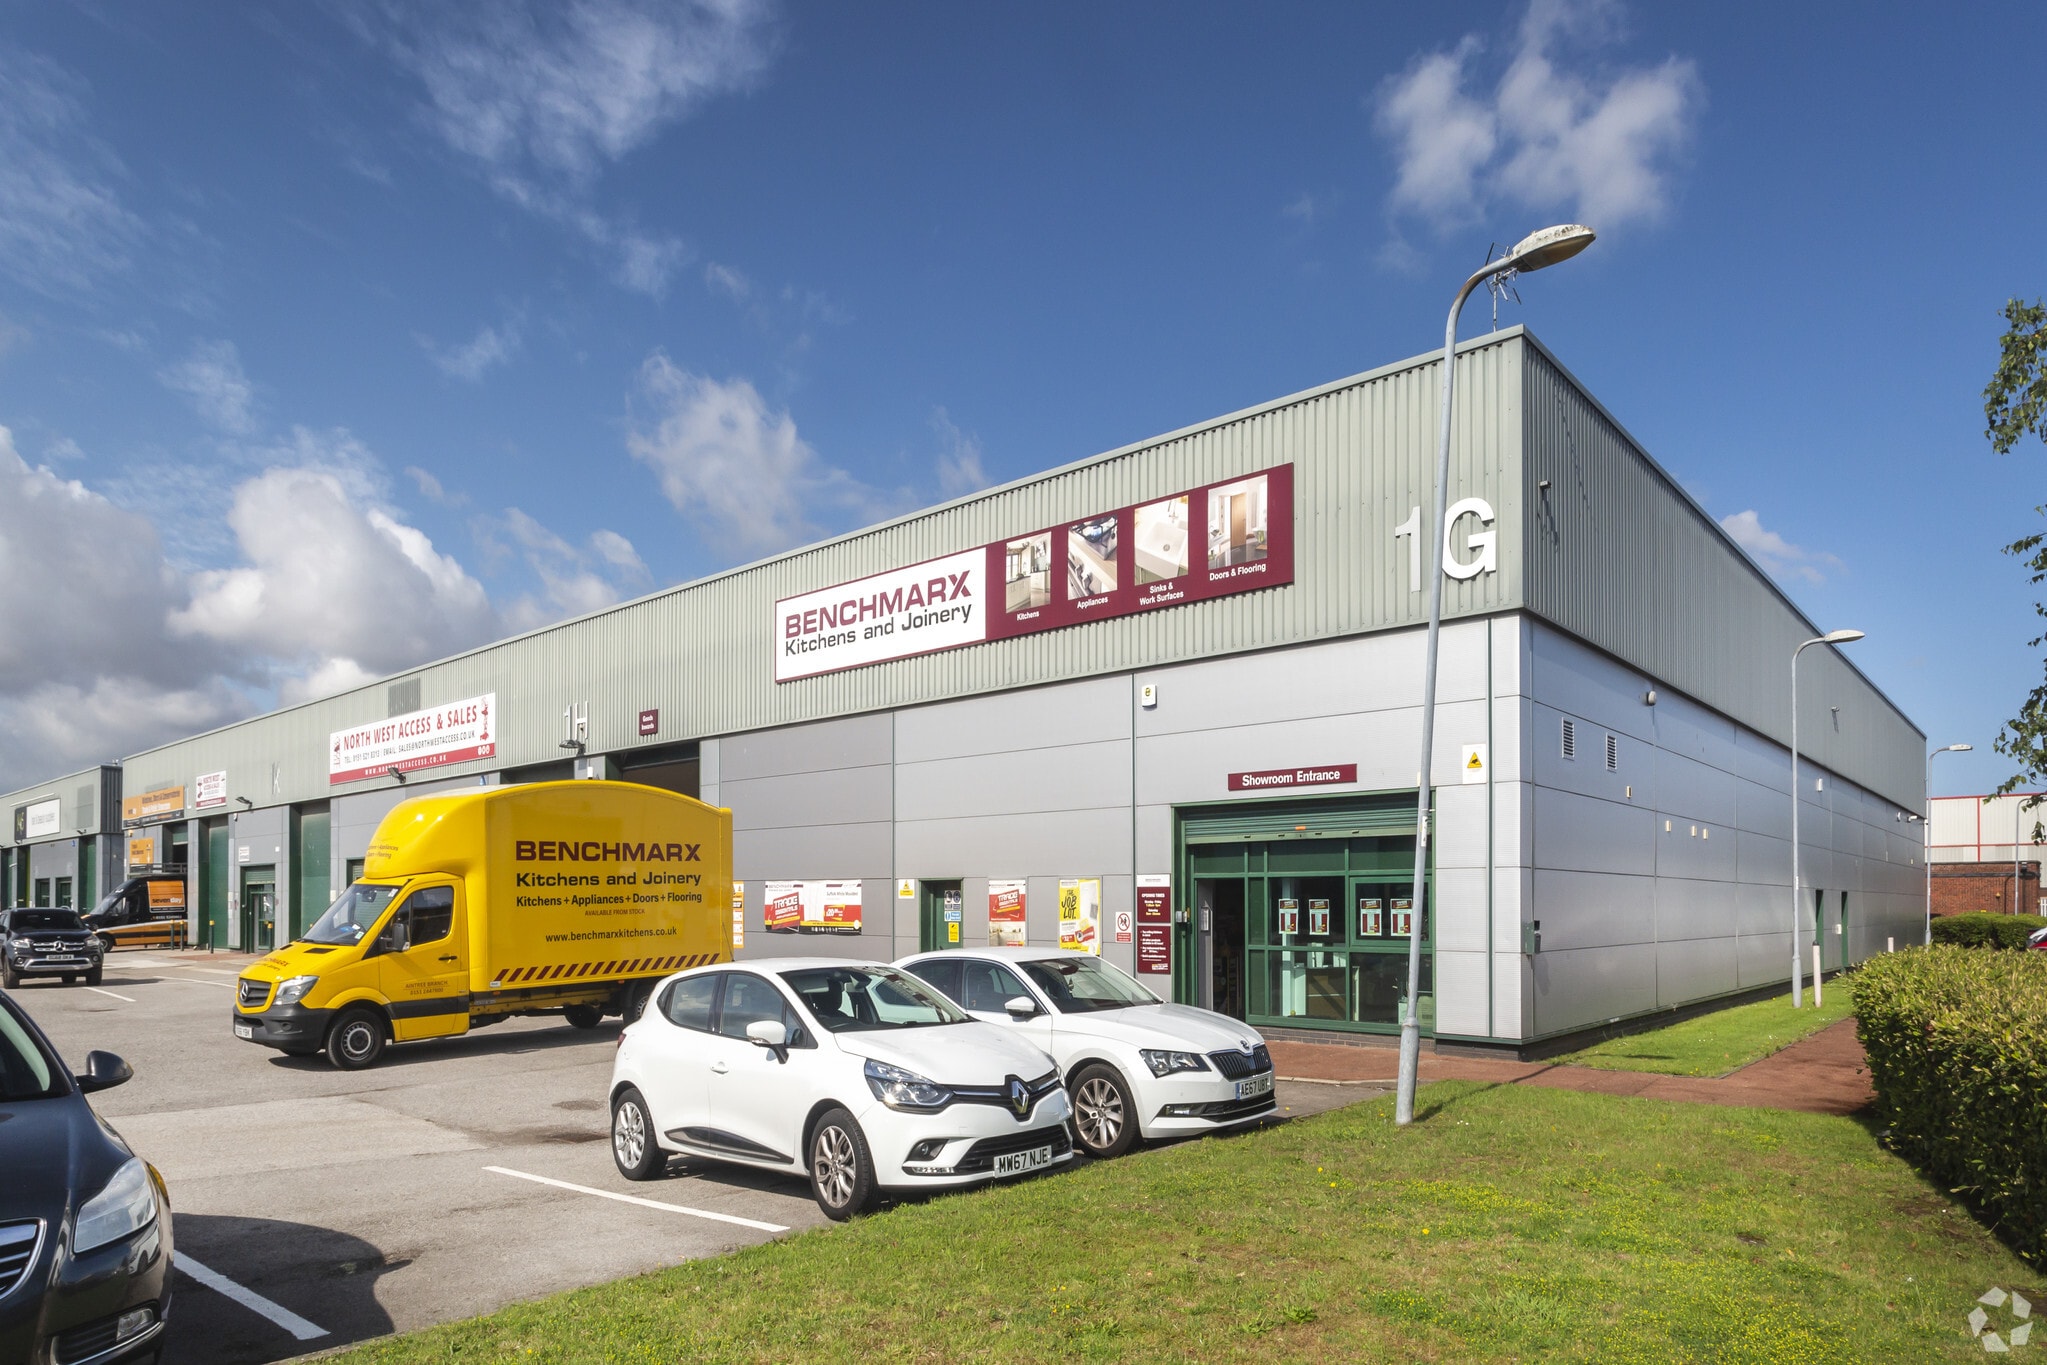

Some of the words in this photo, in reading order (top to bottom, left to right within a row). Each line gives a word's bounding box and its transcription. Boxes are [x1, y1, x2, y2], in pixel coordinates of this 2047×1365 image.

[1209, 572, 1230, 581] Doors
[1231, 568, 1236, 576] &
[1238, 563, 1266, 576] Flooring
[1150, 584, 1167, 594] Sinks
[1168, 582, 1173, 590] &
[786, 570, 972, 638] BENCHMARX
[1077, 596, 1108, 609] Appliances
[1140, 596, 1156, 606] Work
[1157, 591, 1184, 602] Surfaces
[1016, 611, 1039, 621] Kitchens
[786, 630, 856, 656] Kitchens
[864, 618, 894, 640] and
[902, 604, 972, 630] Joinery
[344, 732, 370, 750] NORTH
[374, 725, 396, 744] WEST
[398, 716, 431, 738] ACCESS
[436, 713, 443, 730] &
[447, 705, 477, 727] SALES
[1242, 774, 1293, 786] Showroom
[1297, 770, 1340, 782] Entrance
[516, 840, 701, 862] BENCHMARX
[516, 873, 599, 887] Kitchens
[606, 872, 636, 885] and
[643, 872, 701, 886] Joinery
[516, 895, 562, 907] Kitchens
[571, 893, 624, 907] Appliances
[633, 893, 659, 903] Doors
[667, 892, 702, 903] Flooring
[1061, 896, 1077, 908] JOB
[546, 926, 677, 942] www.benchmarxkitchens.co.uk
[1241, 1081, 1256, 1096] AE67
[998, 1153, 1027, 1173] MW67
[1029, 1146, 1048, 1167] NJE
